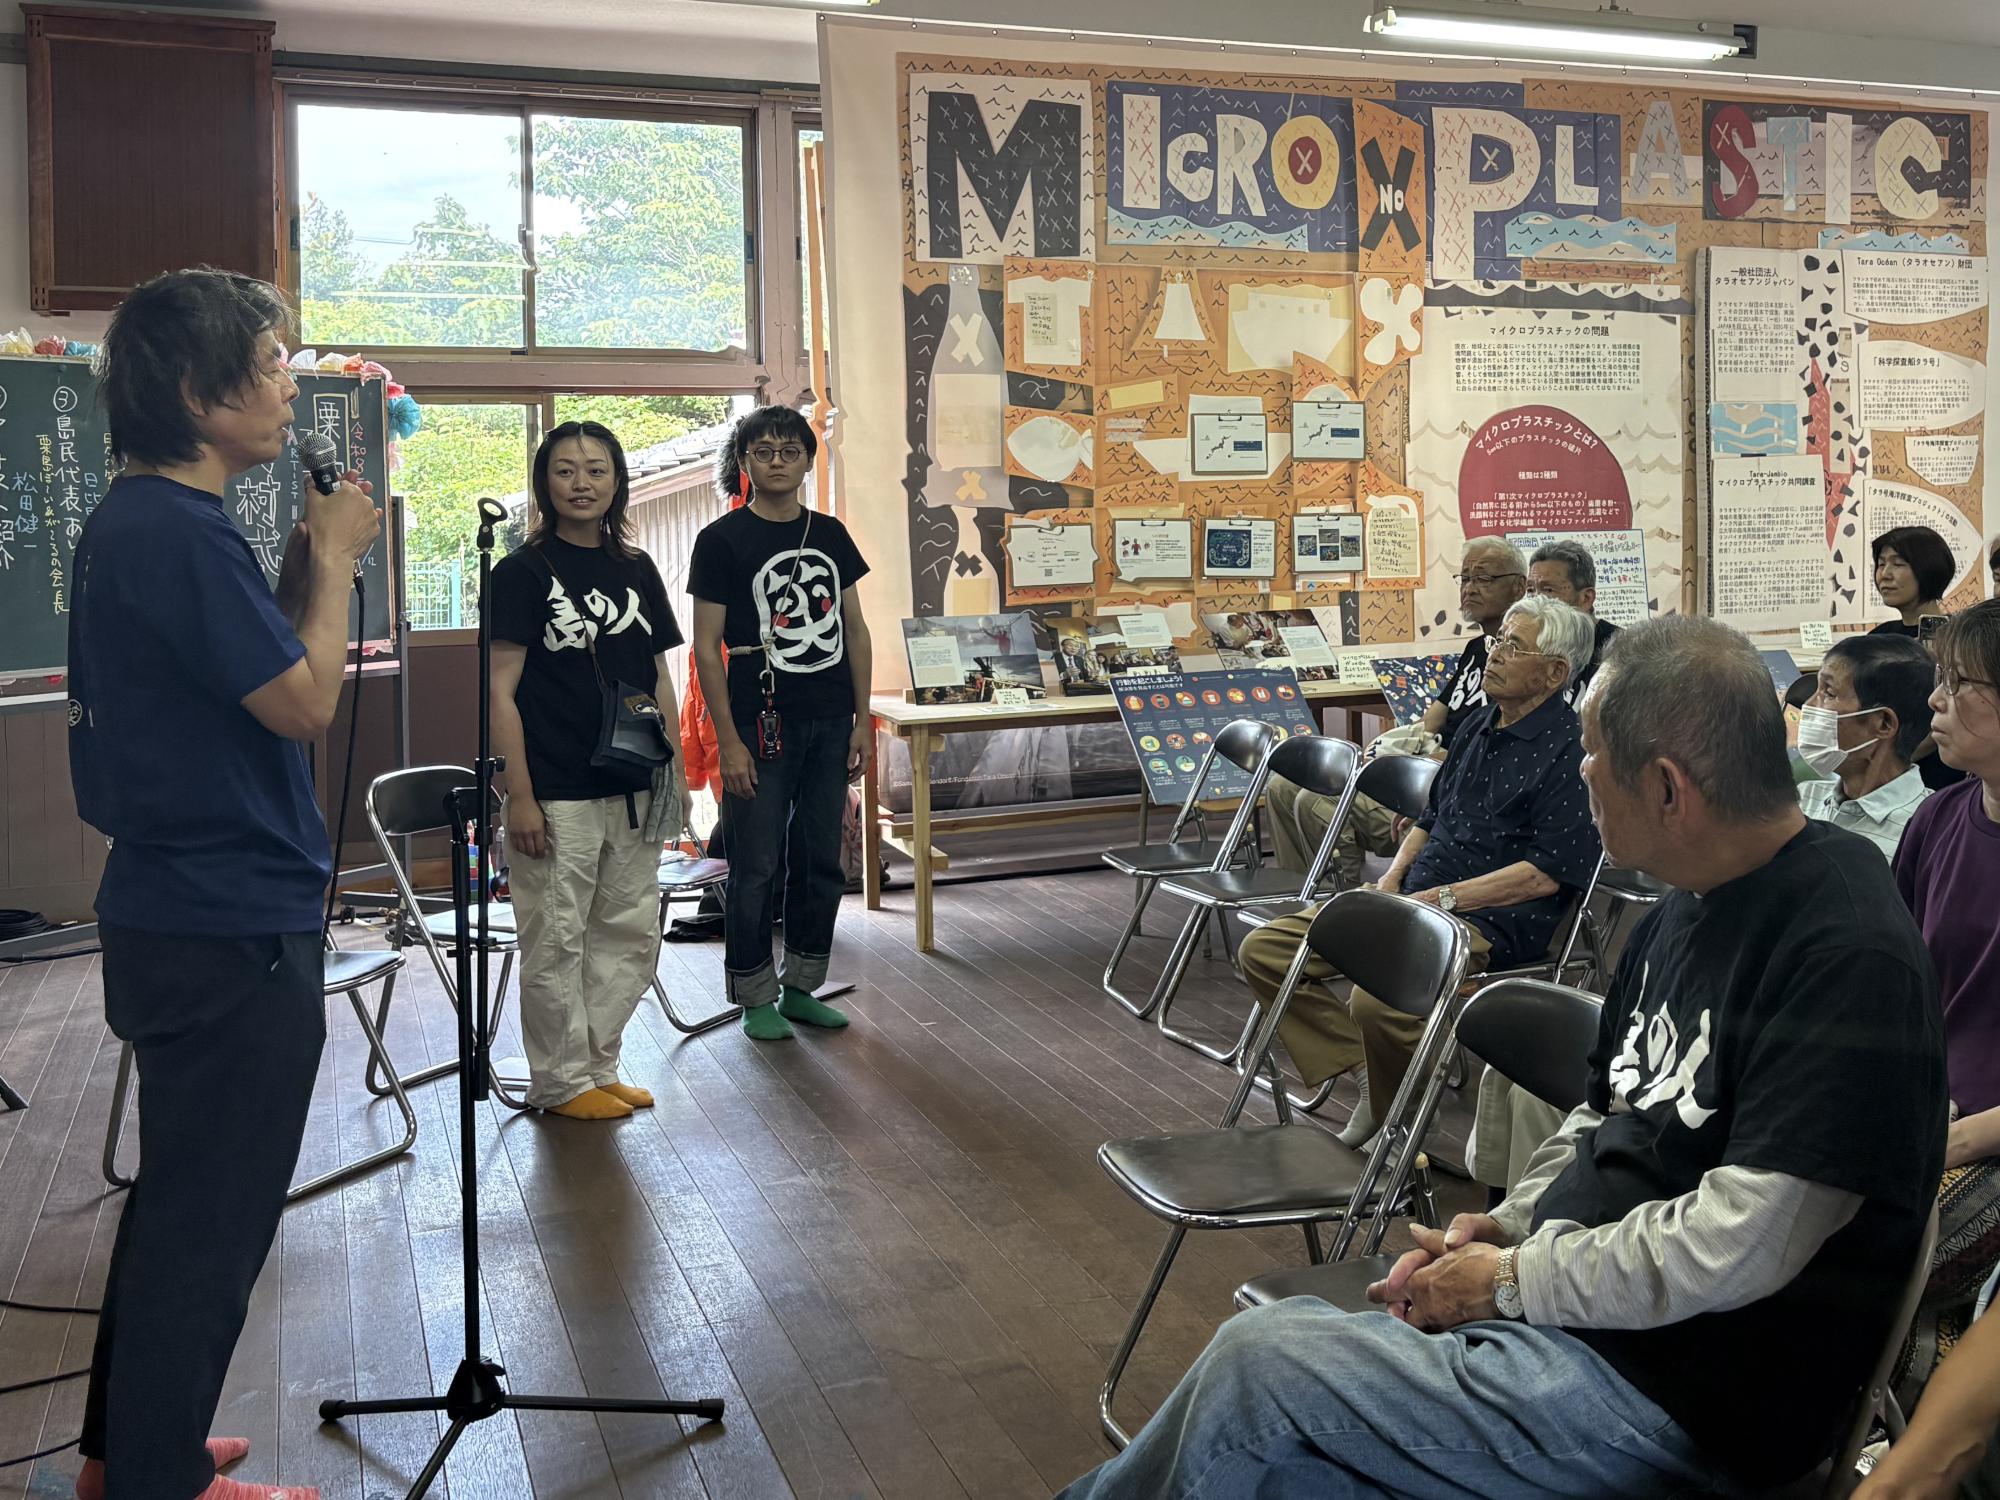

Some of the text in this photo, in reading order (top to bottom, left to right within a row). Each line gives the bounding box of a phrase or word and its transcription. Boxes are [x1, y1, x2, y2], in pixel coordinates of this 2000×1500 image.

[1432, 100, 1942, 280] PLASTIC
[1857, 257, 1874, 265] Tara
[1731, 267, 1779, 277] 一般社団法人
[1715, 277, 1794, 286] タラオセアンジャパン
[1490, 326, 1610, 337] マイクロプラスチックの問題
[1873, 357, 1940, 367] 「科学探査船タラ号」
[350, 422, 367, 486] 令和8
[1718, 478, 1816, 487] マイクロプラスチック共同調査
[12, 472, 39, 548] 松田健一
[542, 576, 652, 652] 島の人
[1609, 960, 1719, 1129] 島の人
